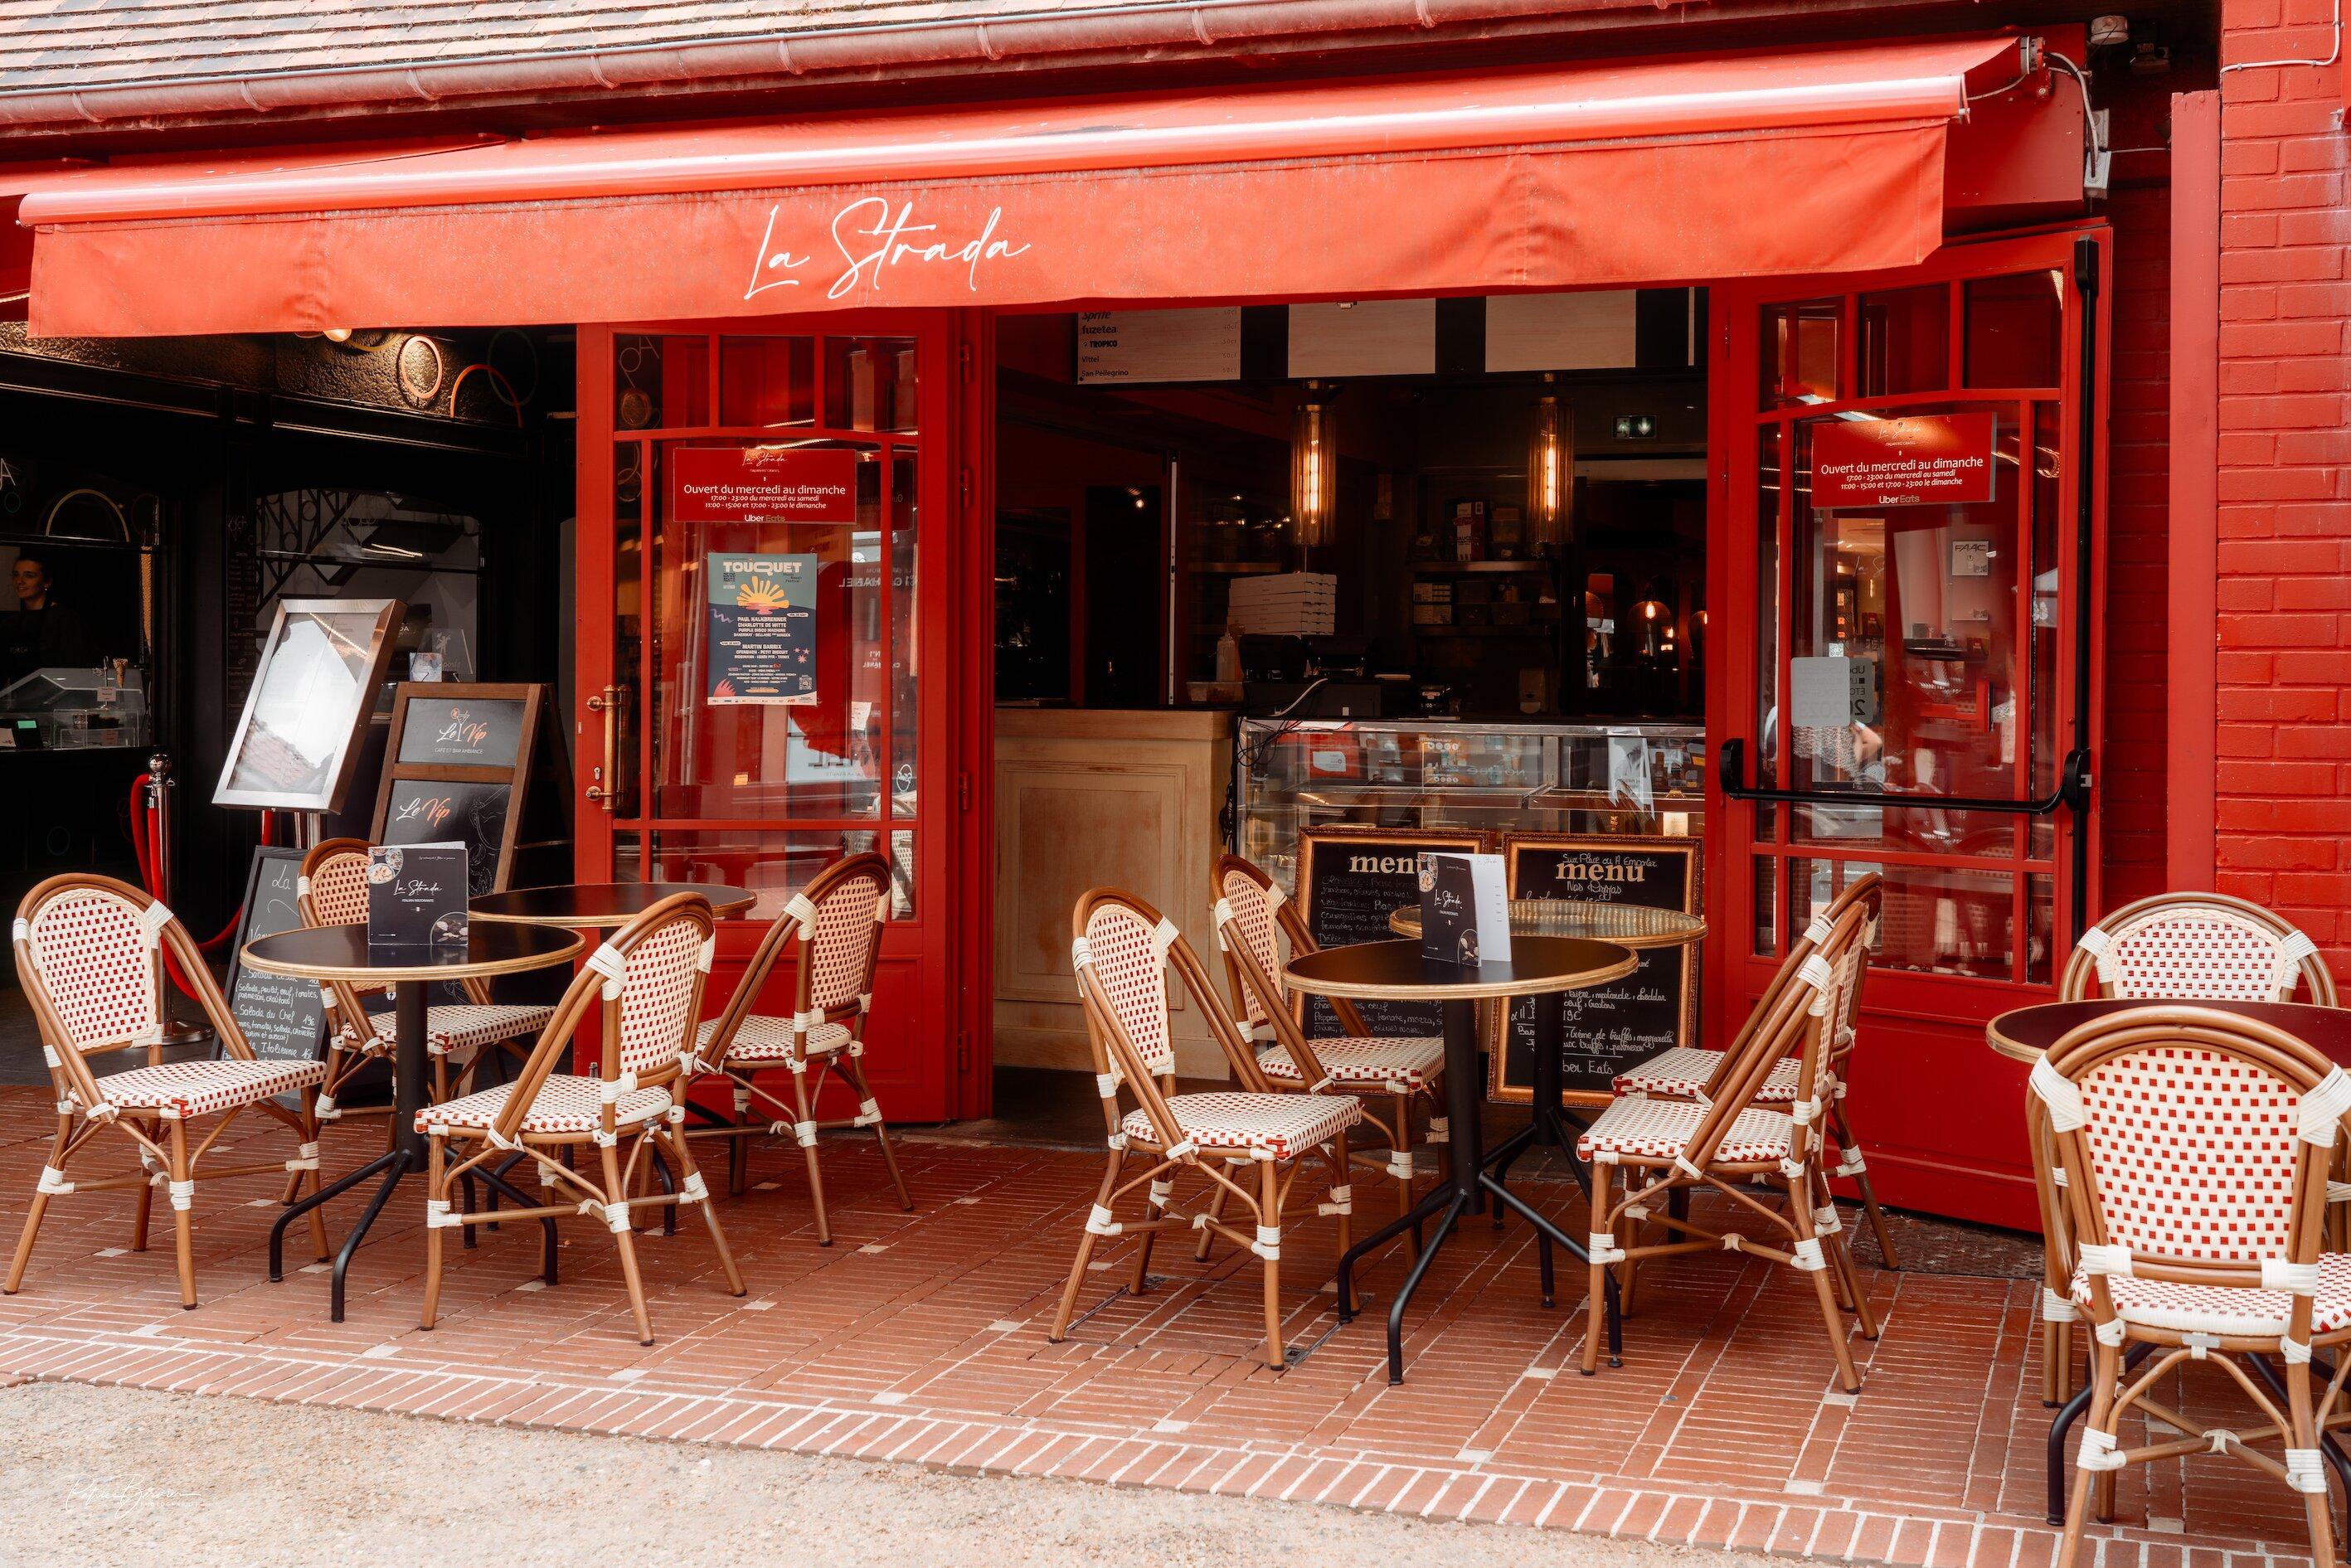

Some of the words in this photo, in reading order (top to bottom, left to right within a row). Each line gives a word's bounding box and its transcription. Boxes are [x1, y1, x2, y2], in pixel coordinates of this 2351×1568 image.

[743, 204, 810, 300] La
[828, 197, 1032, 299] Strada
[1082, 325, 1117, 334] fuzetea
[742, 452, 753, 466] La
[756, 452, 788, 466] Strada
[1821, 464, 1854, 474] Ouvert
[1857, 464, 1868, 473] du
[1872, 459, 1916, 471] mercredi
[1919, 461, 1931, 469] au
[1935, 457, 1983, 468] dimanche
[1894, 471, 1921, 479] mercredi
[1931, 478, 1962, 486] dimanche
[684, 485, 717, 494] Ouvert
[721, 485, 733, 494] du
[736, 485, 780, 494] mercredi
[798, 485, 845, 495] dimanche
[723, 561, 802, 575] TOUQUET
[436, 722, 457, 742] Le
[463, 722, 488, 747] Vip
[396, 798, 420, 821] Le
[423, 798, 451, 828] Vip
[1580, 852, 1600, 864] Place
[1555, 862, 1645, 882] menu
[394, 880, 406, 896] La
[409, 879, 443, 896] Strada
[1434, 889, 1441, 905] La
[1563, 1060, 1582, 1073] ber
